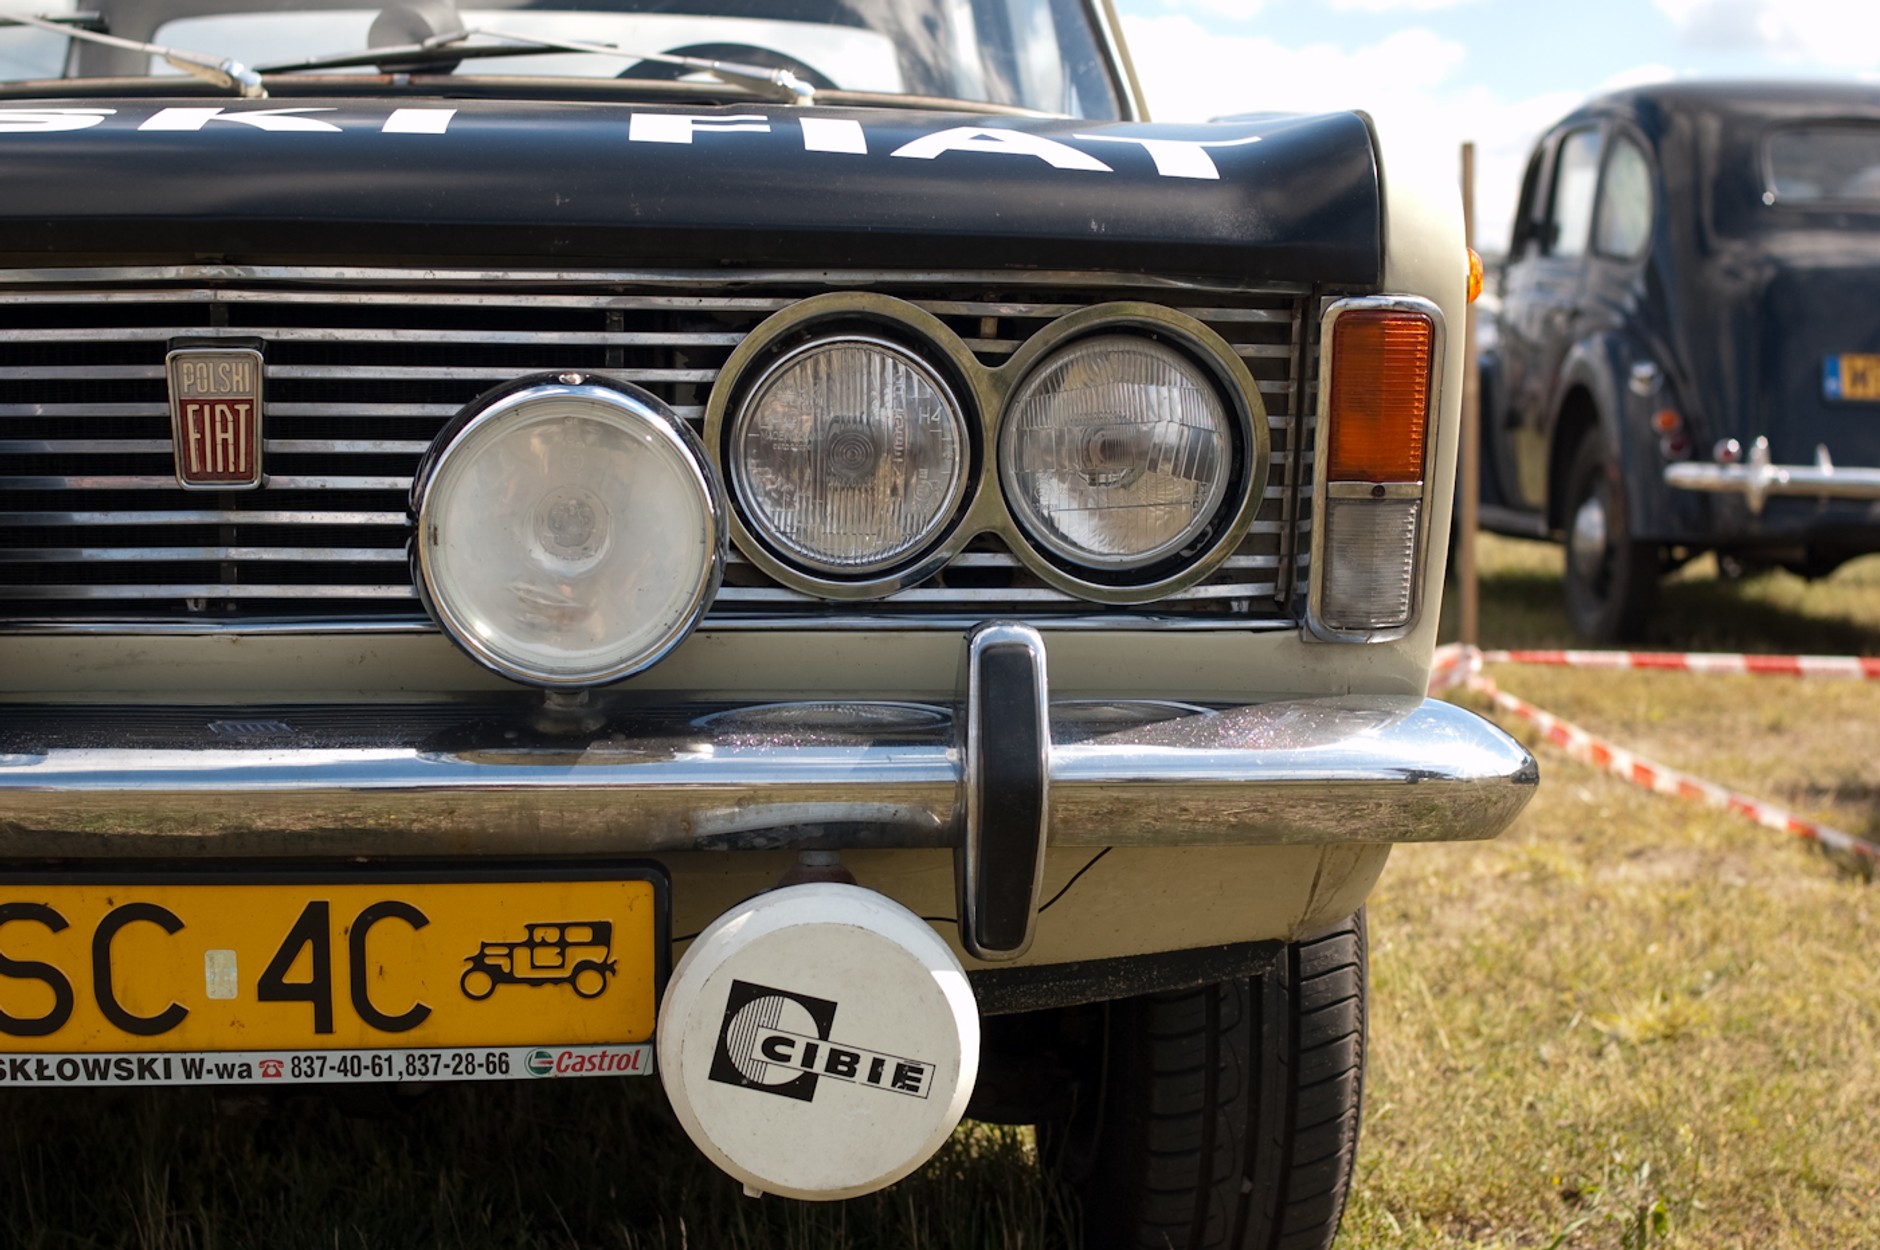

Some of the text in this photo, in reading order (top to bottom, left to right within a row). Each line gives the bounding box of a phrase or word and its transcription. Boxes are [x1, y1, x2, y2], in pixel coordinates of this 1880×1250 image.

[628, 112, 1262, 180] FIAT
[182, 362, 250, 393] POLSKI
[186, 403, 251, 473] FIAT
[918, 406, 942, 425] H4
[257, 899, 433, 1035] 4C
[181, 1057, 253, 1080] W-wa
[555, 1049, 641, 1074] Castrol
[760, 1035, 925, 1094] CIBIE
